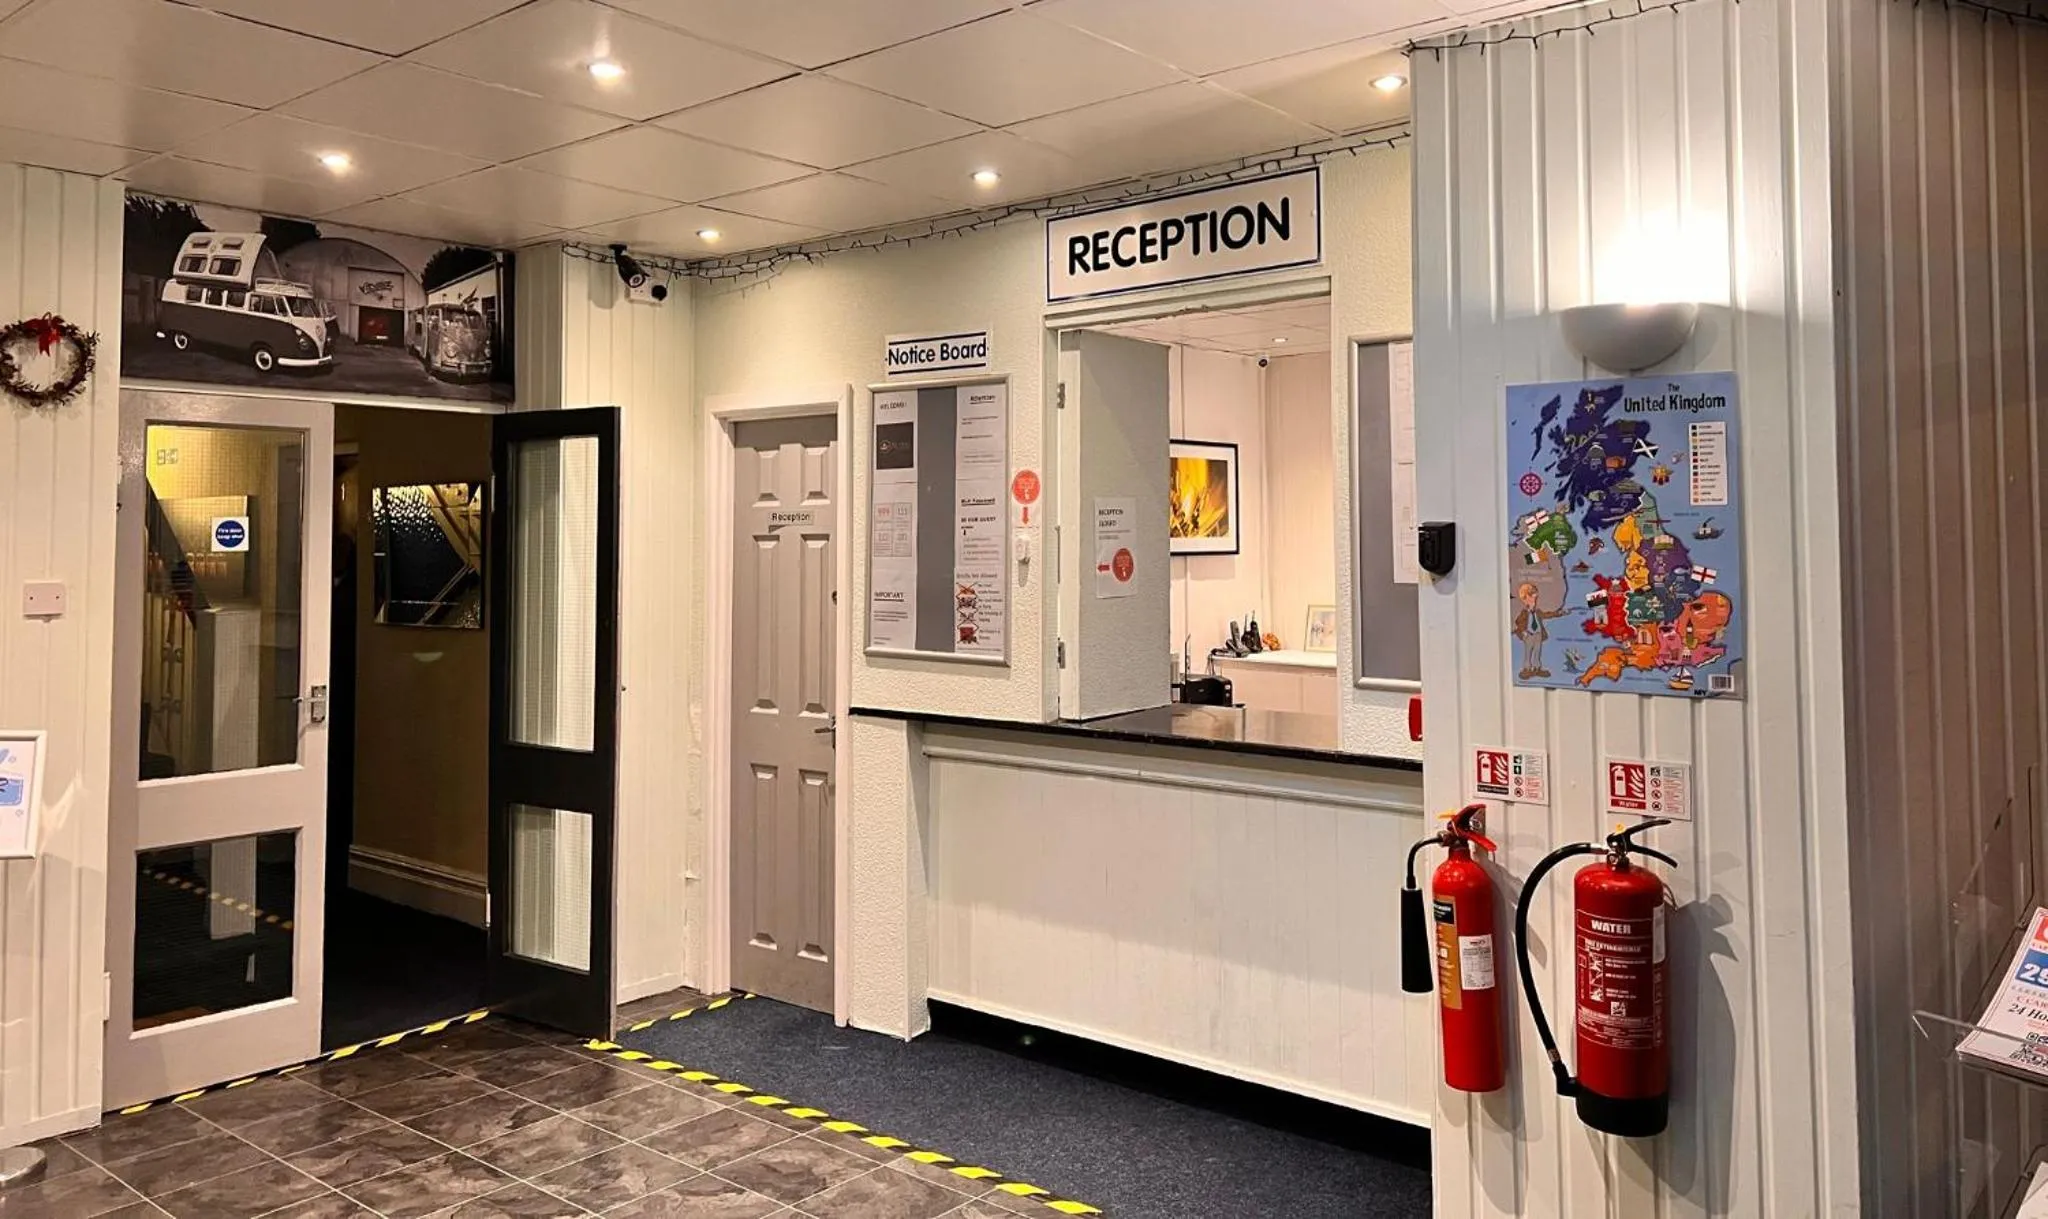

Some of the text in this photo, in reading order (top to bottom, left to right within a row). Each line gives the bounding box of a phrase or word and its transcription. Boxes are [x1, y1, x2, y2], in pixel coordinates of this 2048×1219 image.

[1068, 196, 1290, 276] RECEPTION
[888, 337, 986, 366] Notice Board
[1667, 383, 1680, 392] The
[1624, 392, 1726, 413] United Kingdom
[771, 512, 809, 522] Reception
[1591, 919, 1632, 935] WATER
